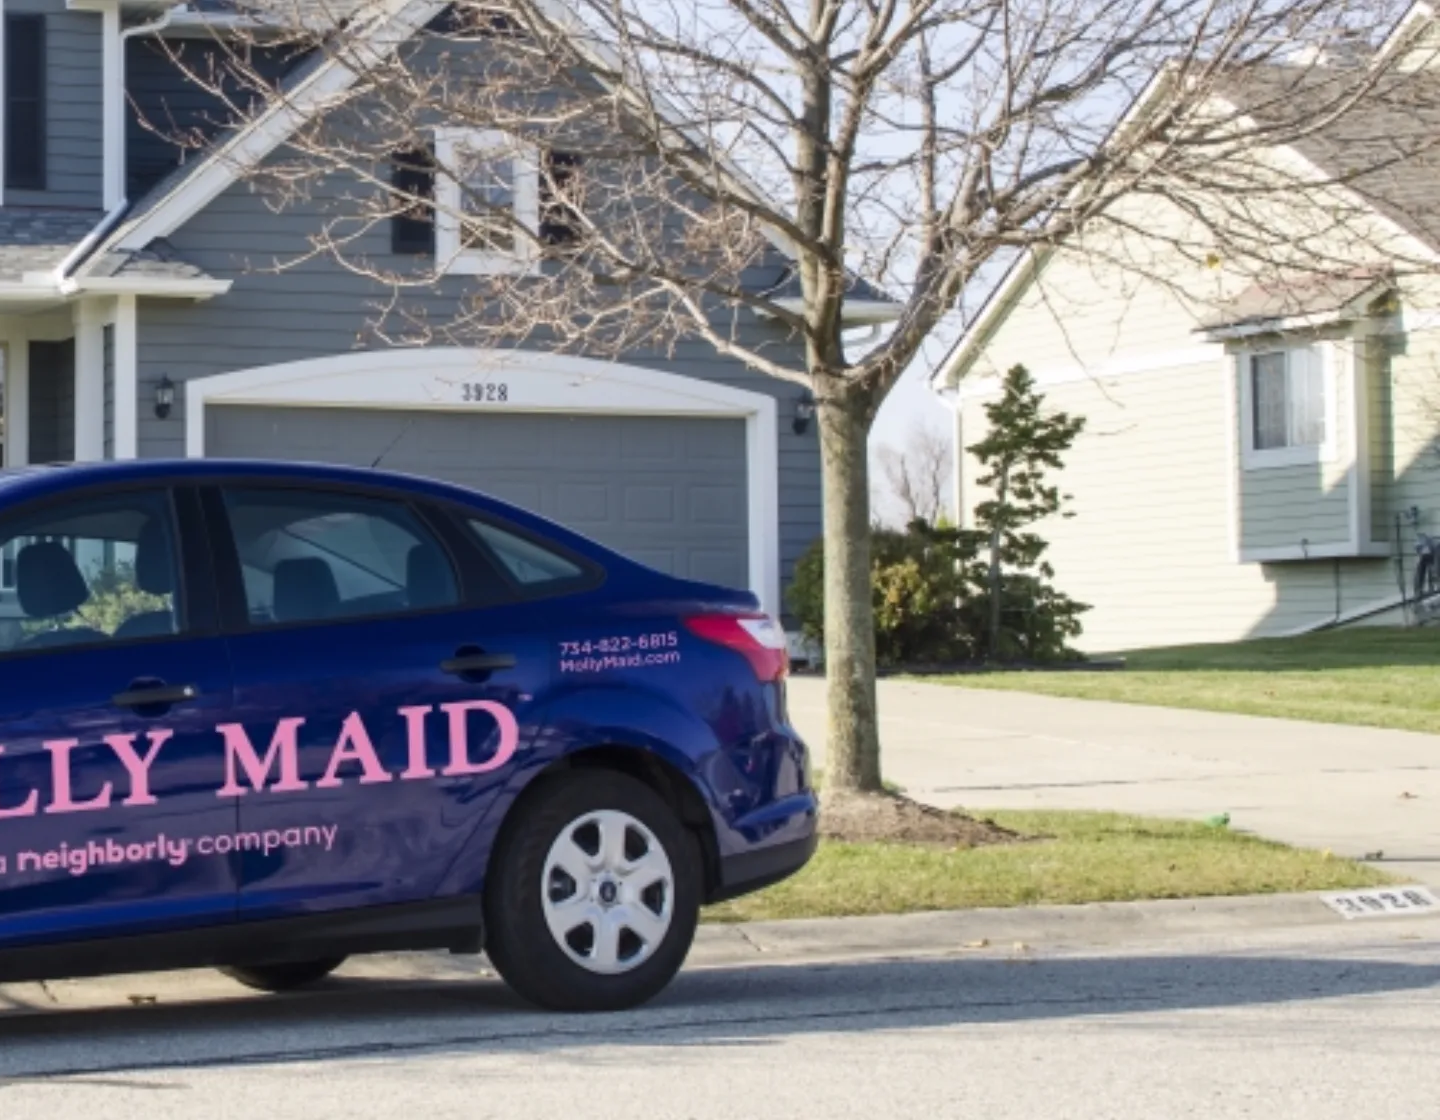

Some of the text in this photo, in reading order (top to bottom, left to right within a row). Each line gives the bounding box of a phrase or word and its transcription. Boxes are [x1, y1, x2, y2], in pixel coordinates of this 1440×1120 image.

[462, 382, 508, 402] 3928
[559, 631, 678, 656] 734-822-6815
[560, 651, 681, 673] MollyMaid.com
[217, 699, 519, 798] MAID
[16, 833, 189, 876] neighborly
[197, 824, 338, 857] company
